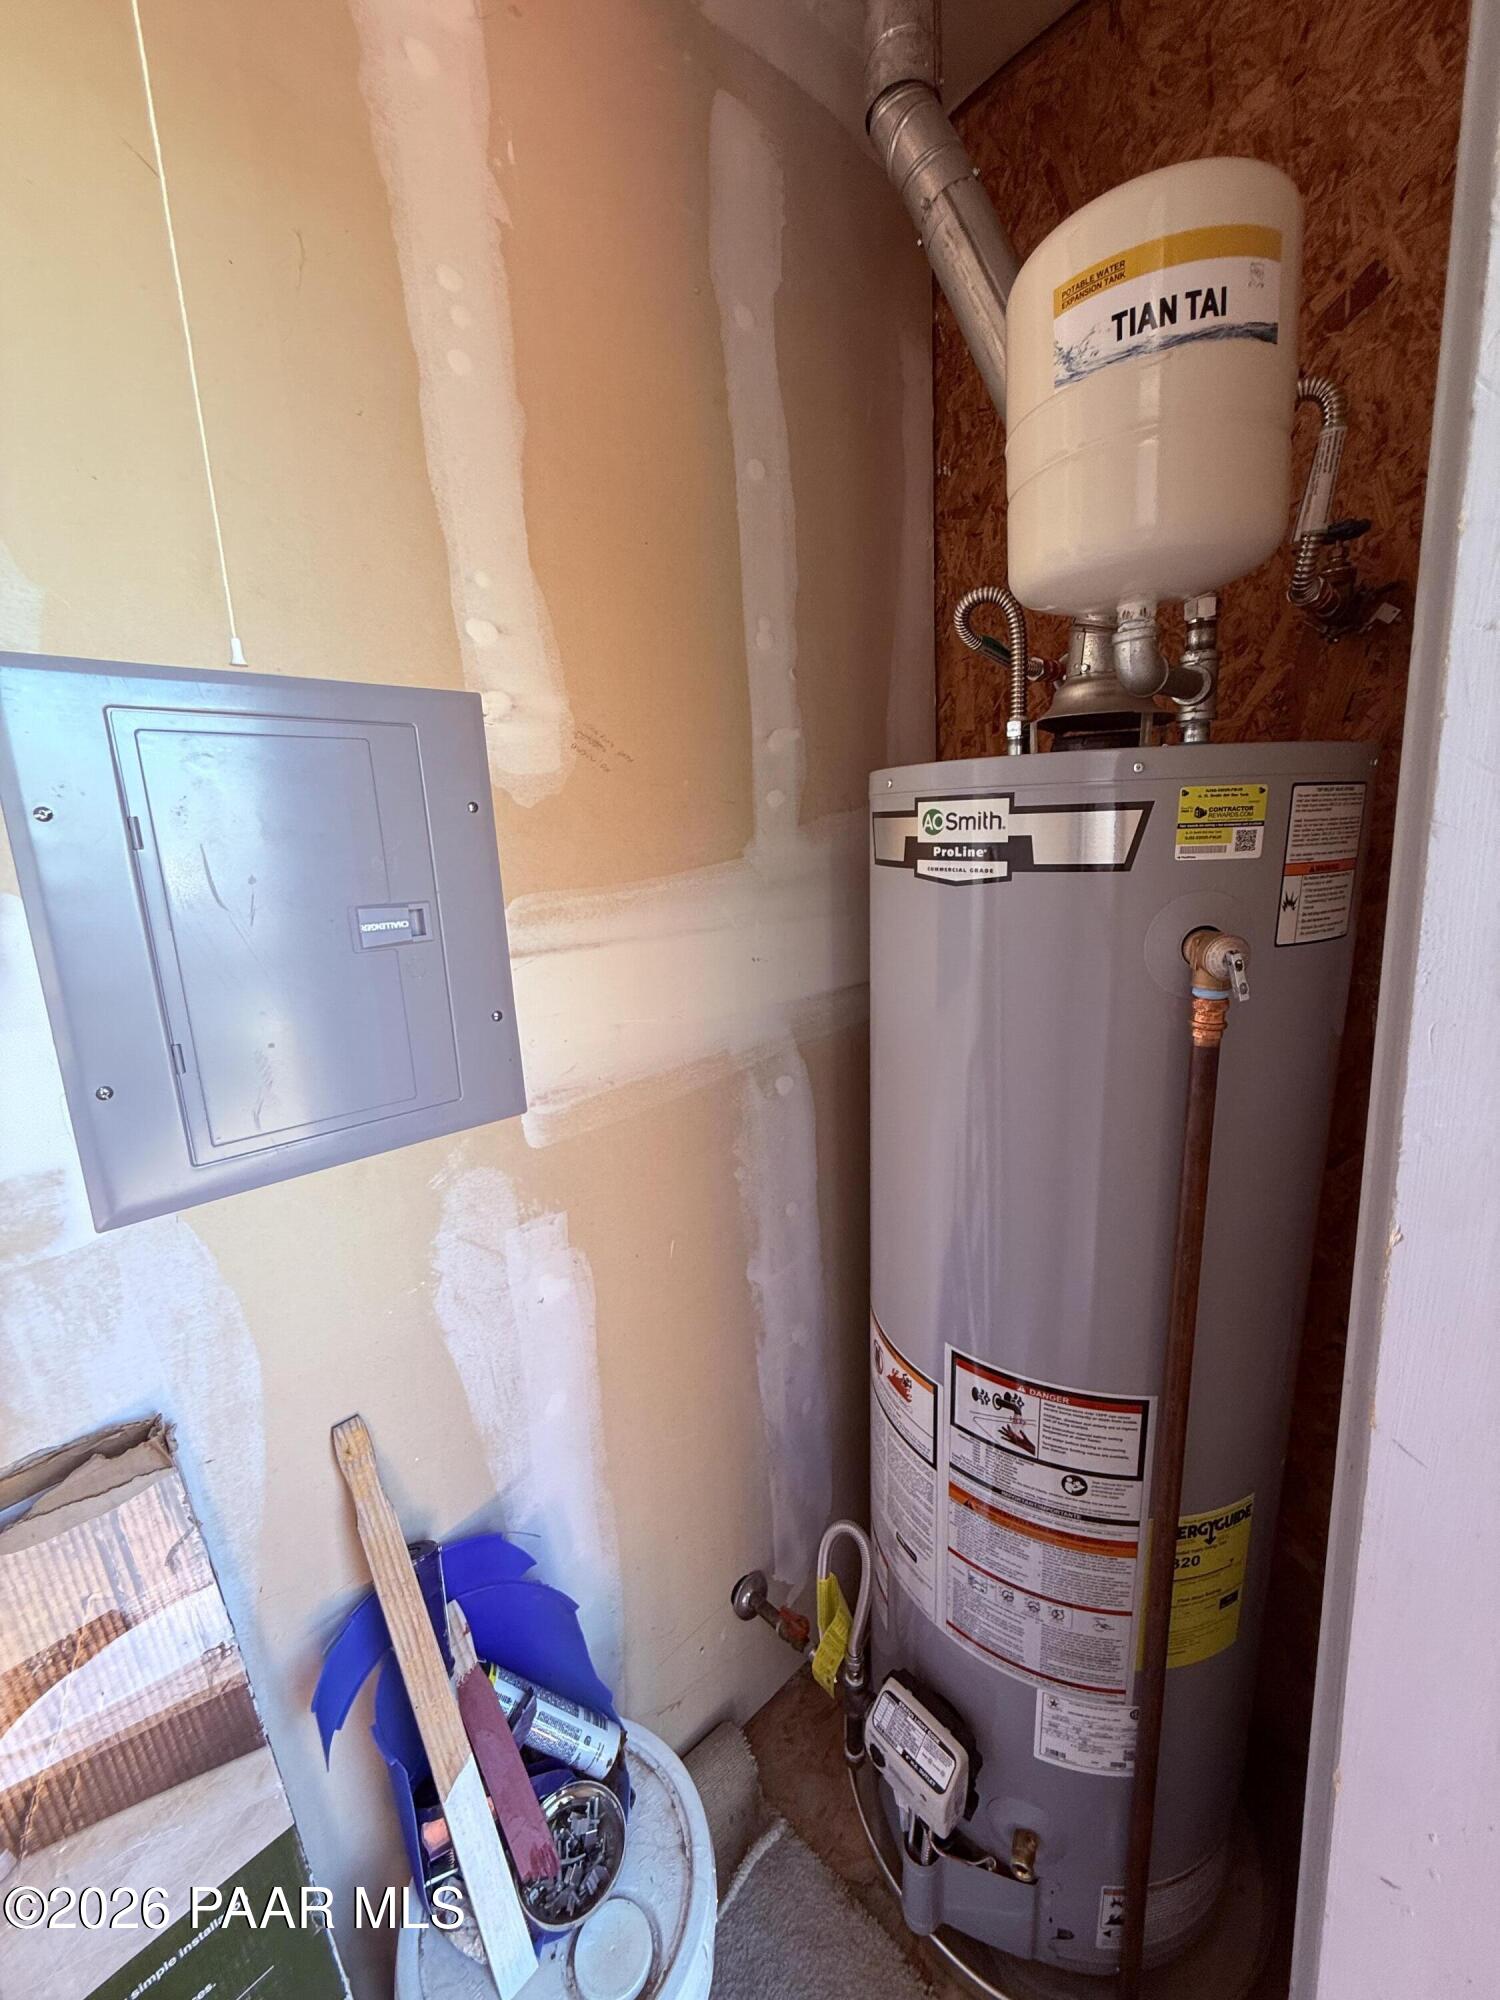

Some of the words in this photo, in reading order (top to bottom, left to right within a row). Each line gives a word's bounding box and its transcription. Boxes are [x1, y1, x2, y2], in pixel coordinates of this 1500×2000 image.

[1061, 273, 1095, 300] POTABLE
[1096, 259, 1126, 279] WATER
[1061, 281, 1102, 310] EXPANSION
[1104, 270, 1126, 287] TANK
[1111, 294, 1178, 342] TIAN
[1184, 286, 1228, 321] TAI
[1208, 805, 1254, 813] CONTRACTOR
[927, 866, 967, 874] COMMERCIAL
[1029, 1388, 1070, 1404] DANGER
[1176, 1503, 1252, 1545] ERGYGUIDE
[130, 1956, 177, 2000] simple
